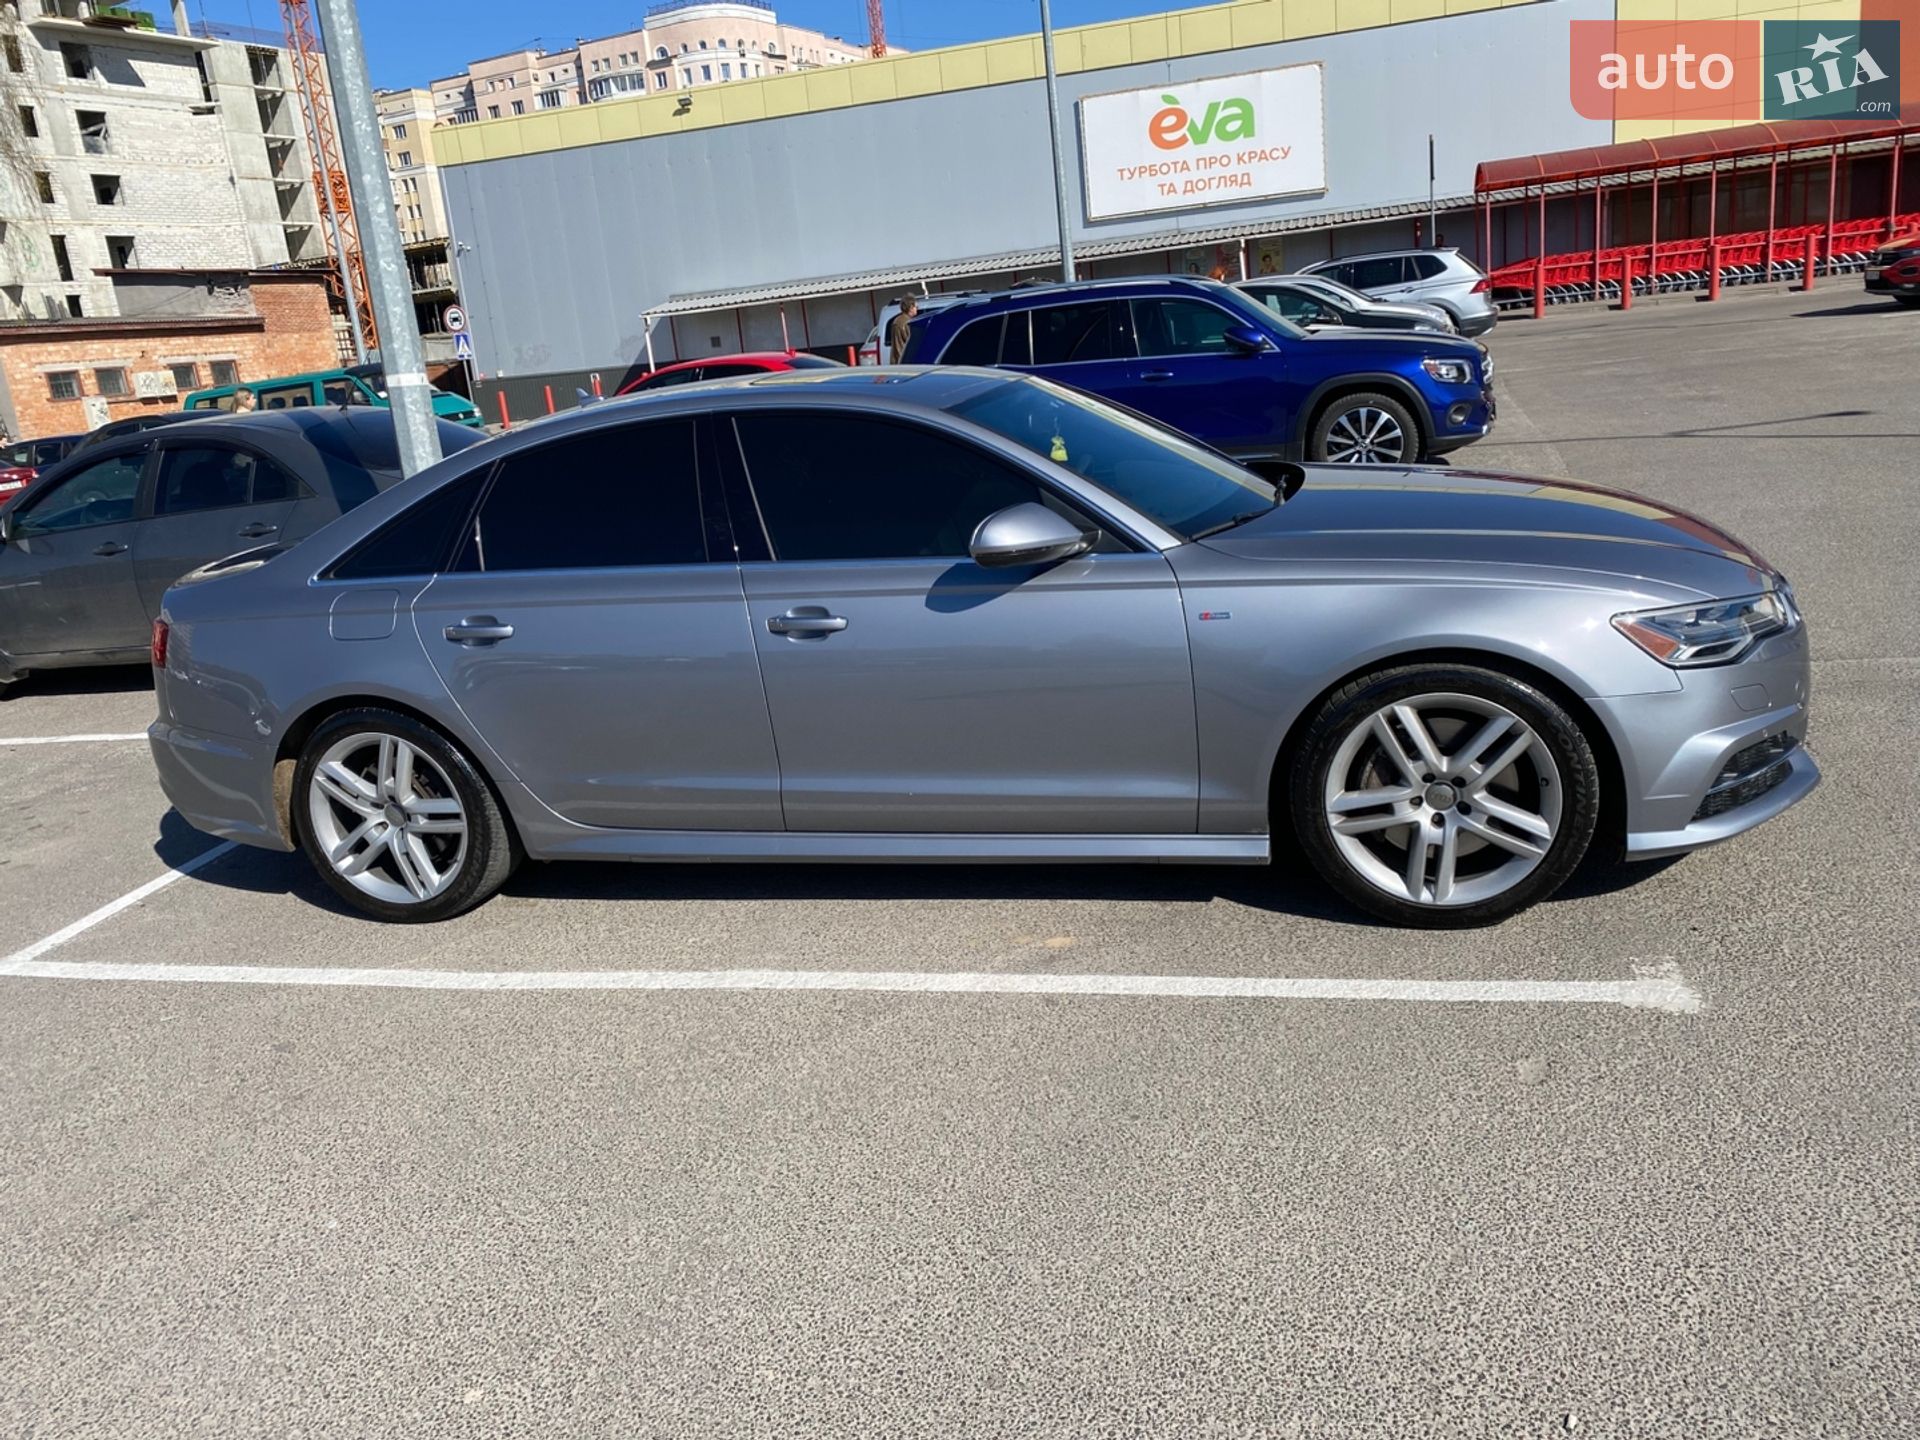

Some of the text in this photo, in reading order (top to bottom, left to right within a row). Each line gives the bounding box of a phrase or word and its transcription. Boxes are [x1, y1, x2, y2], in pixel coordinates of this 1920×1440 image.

[1117, 146, 1292, 181] ТУРБОТА ПРО КРАСУ
[1157, 172, 1252, 197] ТА ДОГЛЯД
